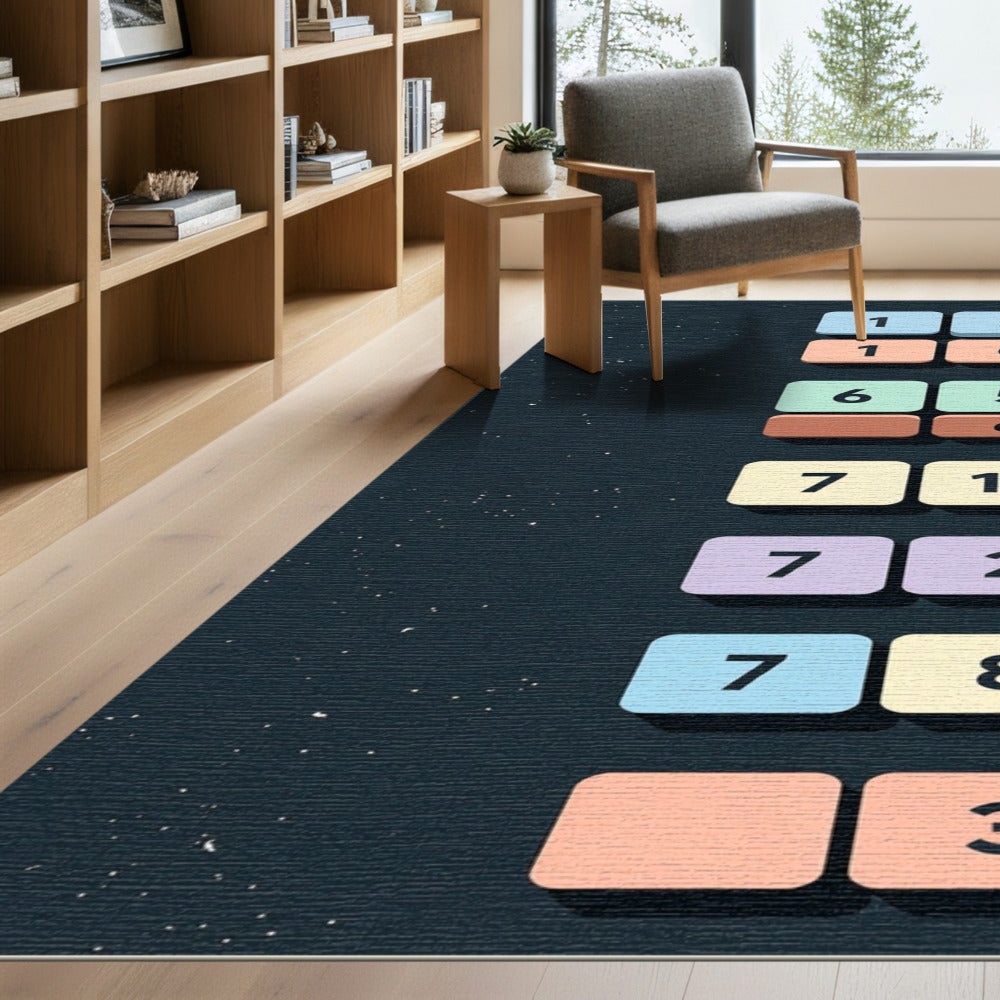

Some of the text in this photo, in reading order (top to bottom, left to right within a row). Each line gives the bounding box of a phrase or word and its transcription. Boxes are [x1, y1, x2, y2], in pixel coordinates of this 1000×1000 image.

[868, 316, 888, 328] 1
[858, 344, 878, 357] 1
[832, 388, 872, 404] 6
[801, 472, 848, 493] 7
[767, 551, 822, 578] 7
[722, 654, 788, 691] 7
